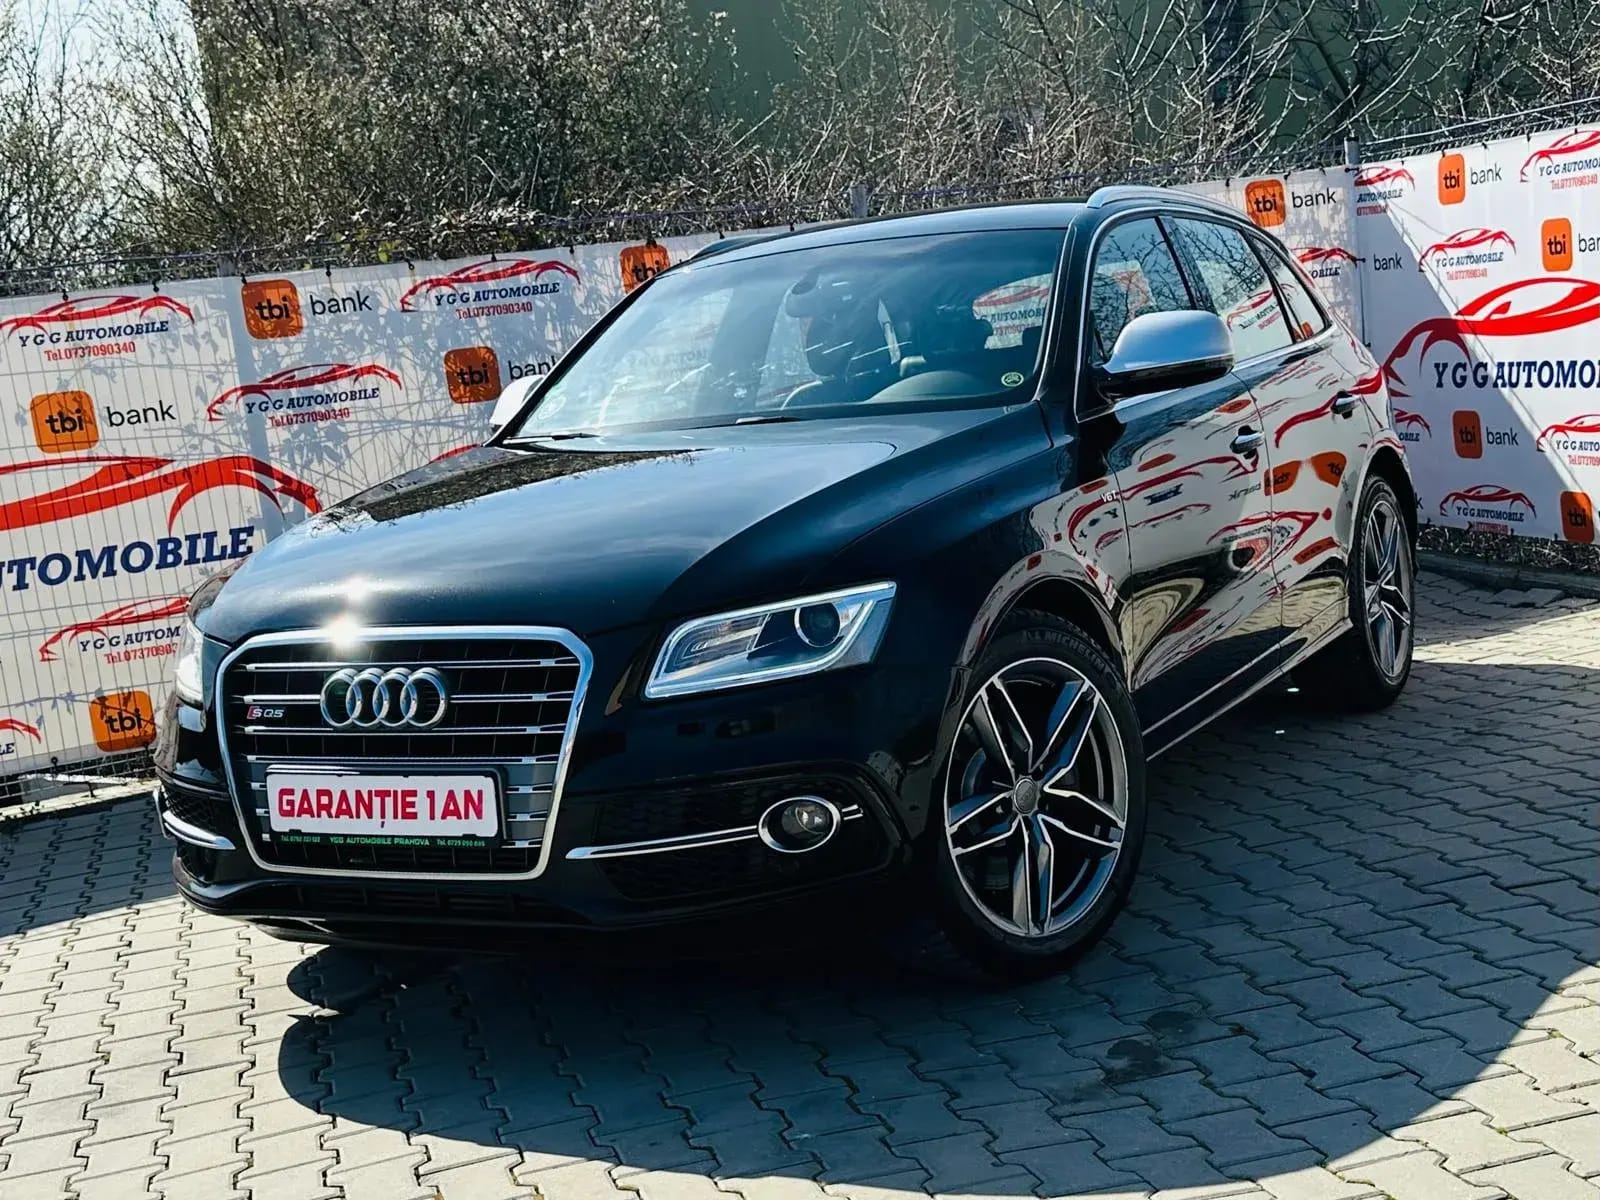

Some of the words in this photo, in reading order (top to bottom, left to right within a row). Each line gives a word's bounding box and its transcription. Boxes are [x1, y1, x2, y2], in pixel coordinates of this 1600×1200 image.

[1443, 169, 1460, 189] tbi
[1470, 164, 1502, 185] bank
[1561, 158, 1600, 173] AUTOMO
[1254, 194, 1277, 213] tbi
[1292, 188, 1336, 208] bank
[1547, 234, 1566, 256] tbi
[1374, 253, 1402, 271] bank
[472, 282, 560, 303] AUTOMOBILE
[255, 296, 290, 321] tbi
[310, 291, 372, 316] bank
[64, 320, 169, 343] AUTOMOBILE
[457, 362, 490, 386] tbi
[1492, 360, 1600, 388] AUTOMO
[286, 387, 380, 410] AUTOMOBILE
[45, 408, 84, 434] tbi
[107, 400, 176, 427] bank
[1459, 424, 1476, 444] tbi
[1486, 427, 1518, 446] bank
[1567, 507, 1587, 528] tbi
[0, 526, 254, 591] TOMOBILE
[124, 626, 180, 645] AUTOM
[105, 709, 142, 734] tbi
[248, 706, 284, 719] SQ5
[277, 787, 418, 828] GARANȚIE
[427, 790, 435, 820] 1
[441, 790, 483, 821] AN
[346, 836, 392, 845] AUTOMOBILE
